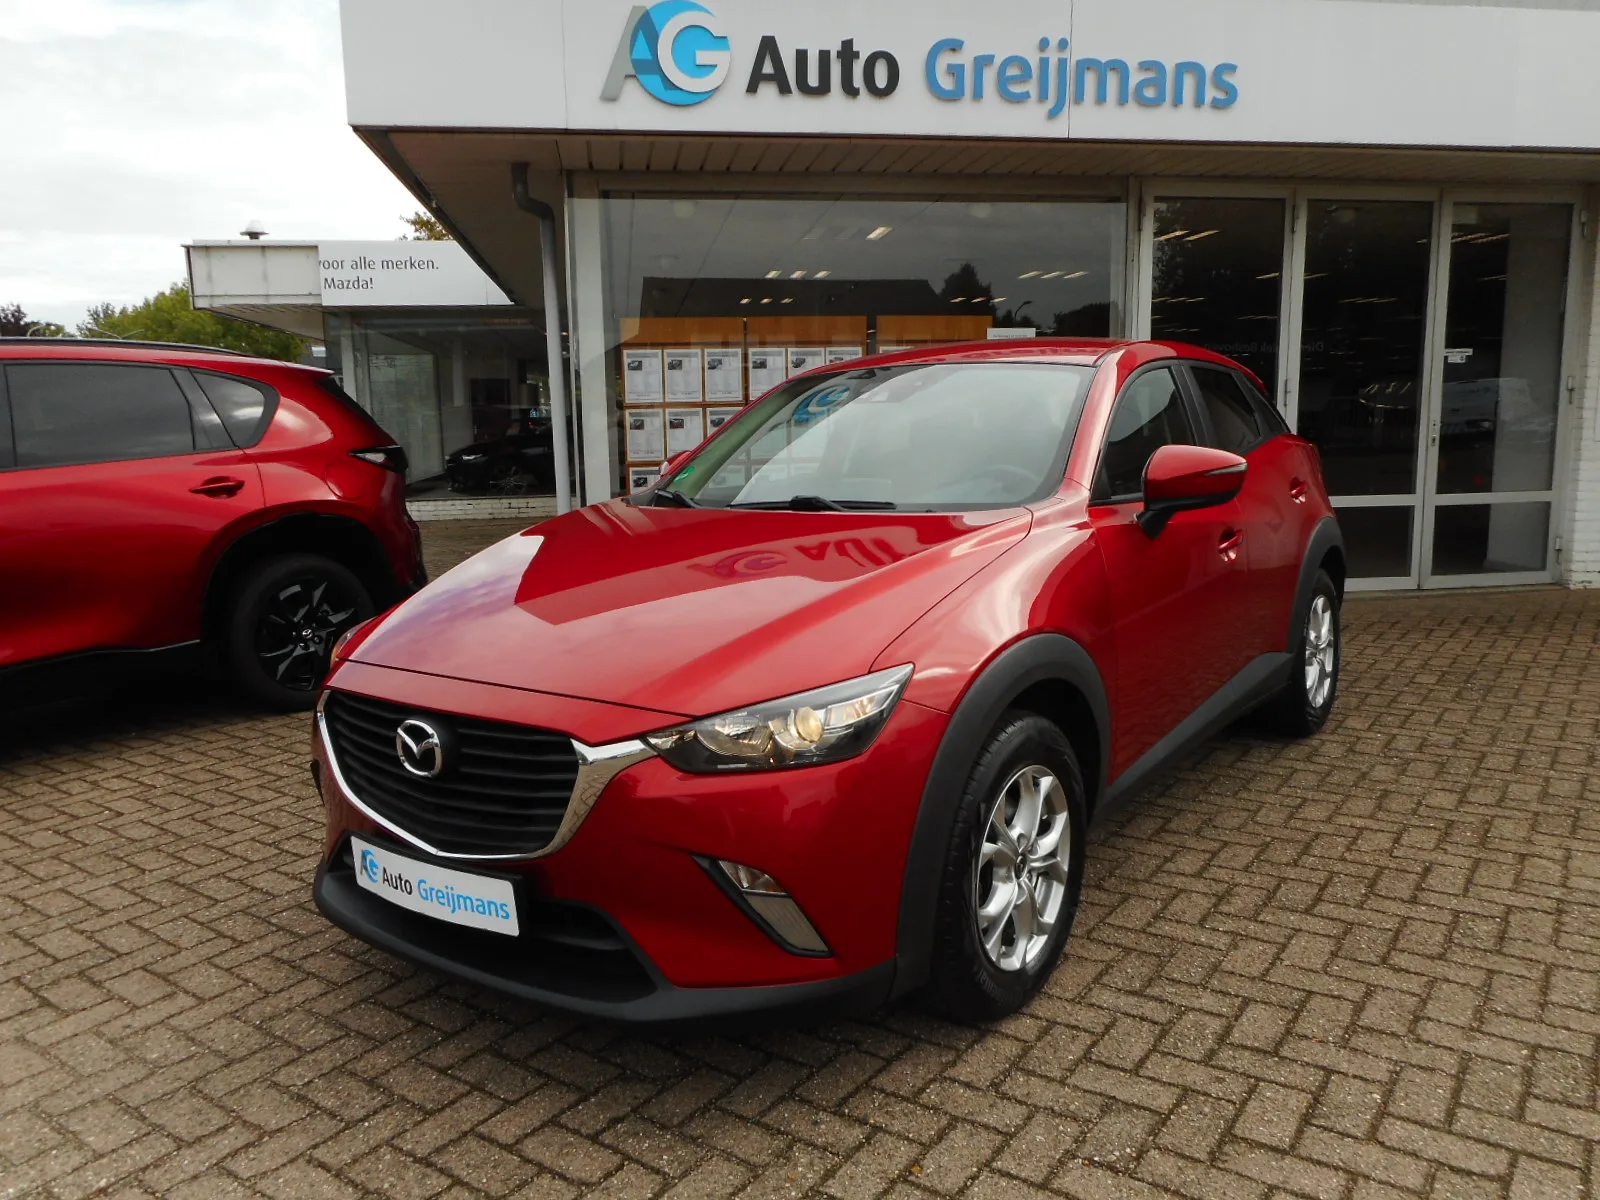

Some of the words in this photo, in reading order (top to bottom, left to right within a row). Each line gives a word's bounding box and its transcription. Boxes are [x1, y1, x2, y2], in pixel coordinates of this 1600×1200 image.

[745, 35, 899, 97] Auto
[925, 37, 1238, 119] Greijmans
[350, 256, 376, 270] alle
[381, 256, 439, 270] merken.
[323, 276, 374, 290] Mazda!
[382, 867, 412, 895] Auto
[417, 879, 510, 919] Greijmans
